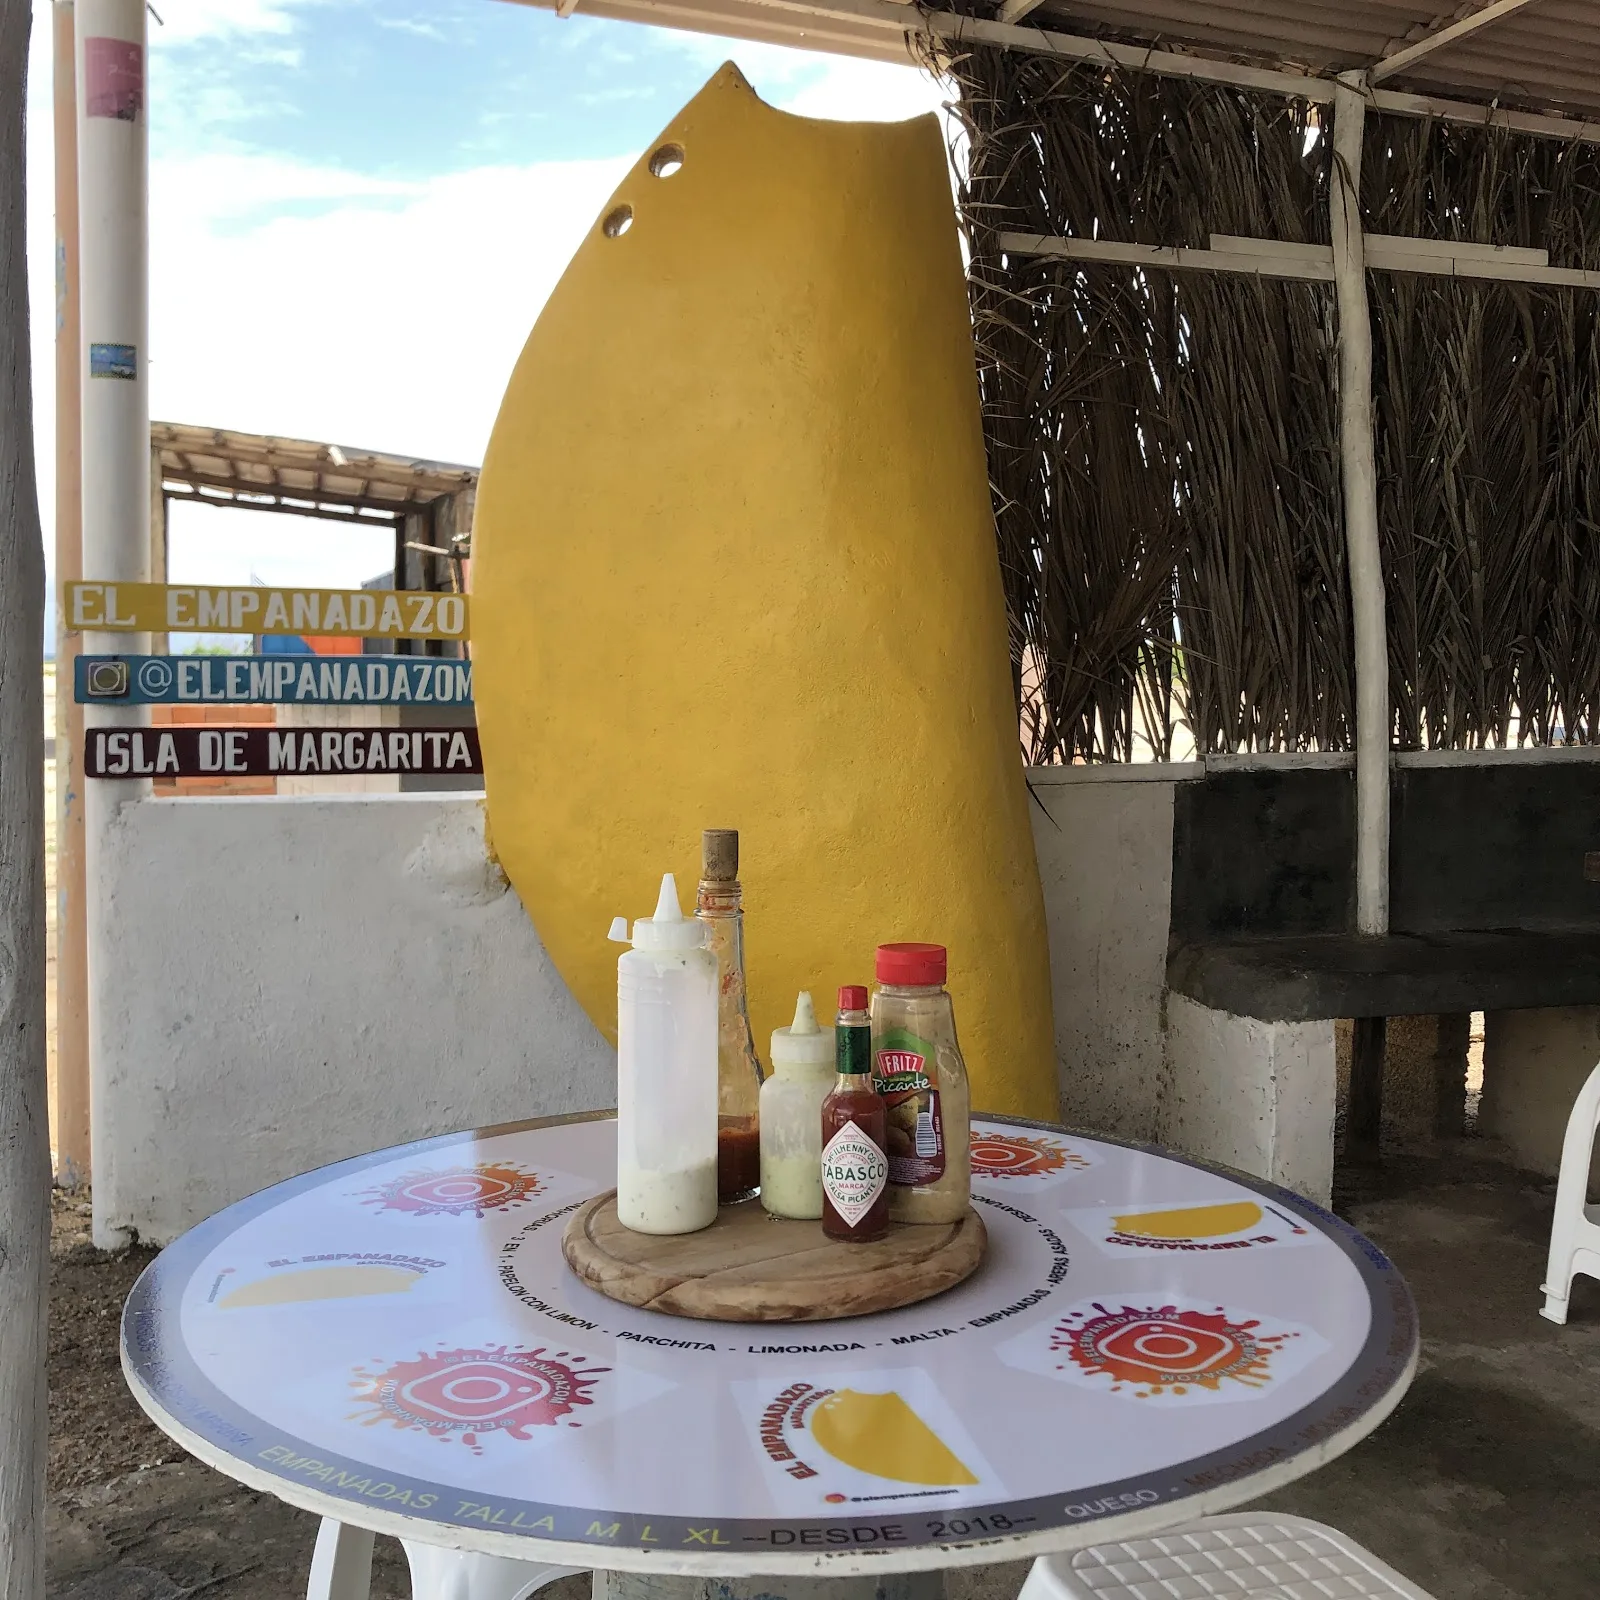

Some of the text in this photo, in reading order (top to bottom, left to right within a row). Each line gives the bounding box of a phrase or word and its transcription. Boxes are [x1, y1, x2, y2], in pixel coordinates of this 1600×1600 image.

[72, 584, 465, 635] EL EMPANADAZO
[98, 730, 473, 775] ISLA DE MARGARITA
[884, 1055, 918, 1073] FRITZ
[872, 1072, 931, 1093] Picante
[823, 1162, 885, 1181] TABASCO
[829, 1181, 877, 1204] SALSA PICANTE
[502, 1243, 521, 1252] EN
[1104, 1236, 1253, 1252] EMPANADAZO
[266, 1252, 447, 1270] EL EMPANADAZO
[1047, 1257, 1070, 1285] AREPAS
[497, 1265, 529, 1297] PAPELON
[520, 1295, 551, 1314] CON
[969, 1288, 1052, 1328] EMPANADAS
[545, 1307, 599, 1330] LIMON
[616, 1330, 717, 1352] PARCHITA
[890, 1327, 959, 1345] MALTA
[748, 1341, 866, 1354] LIMONADA
[760, 1382, 819, 1480] EL EMPANADAZO
[258, 1445, 439, 1510] EMPANADAS
[453, 1501, 555, 1532] TALLA
[585, 1521, 621, 1539] M
[640, 1525, 659, 1542] L
[682, 1527, 731, 1545] XL
[1064, 1488, 1161, 1519] QUESO
